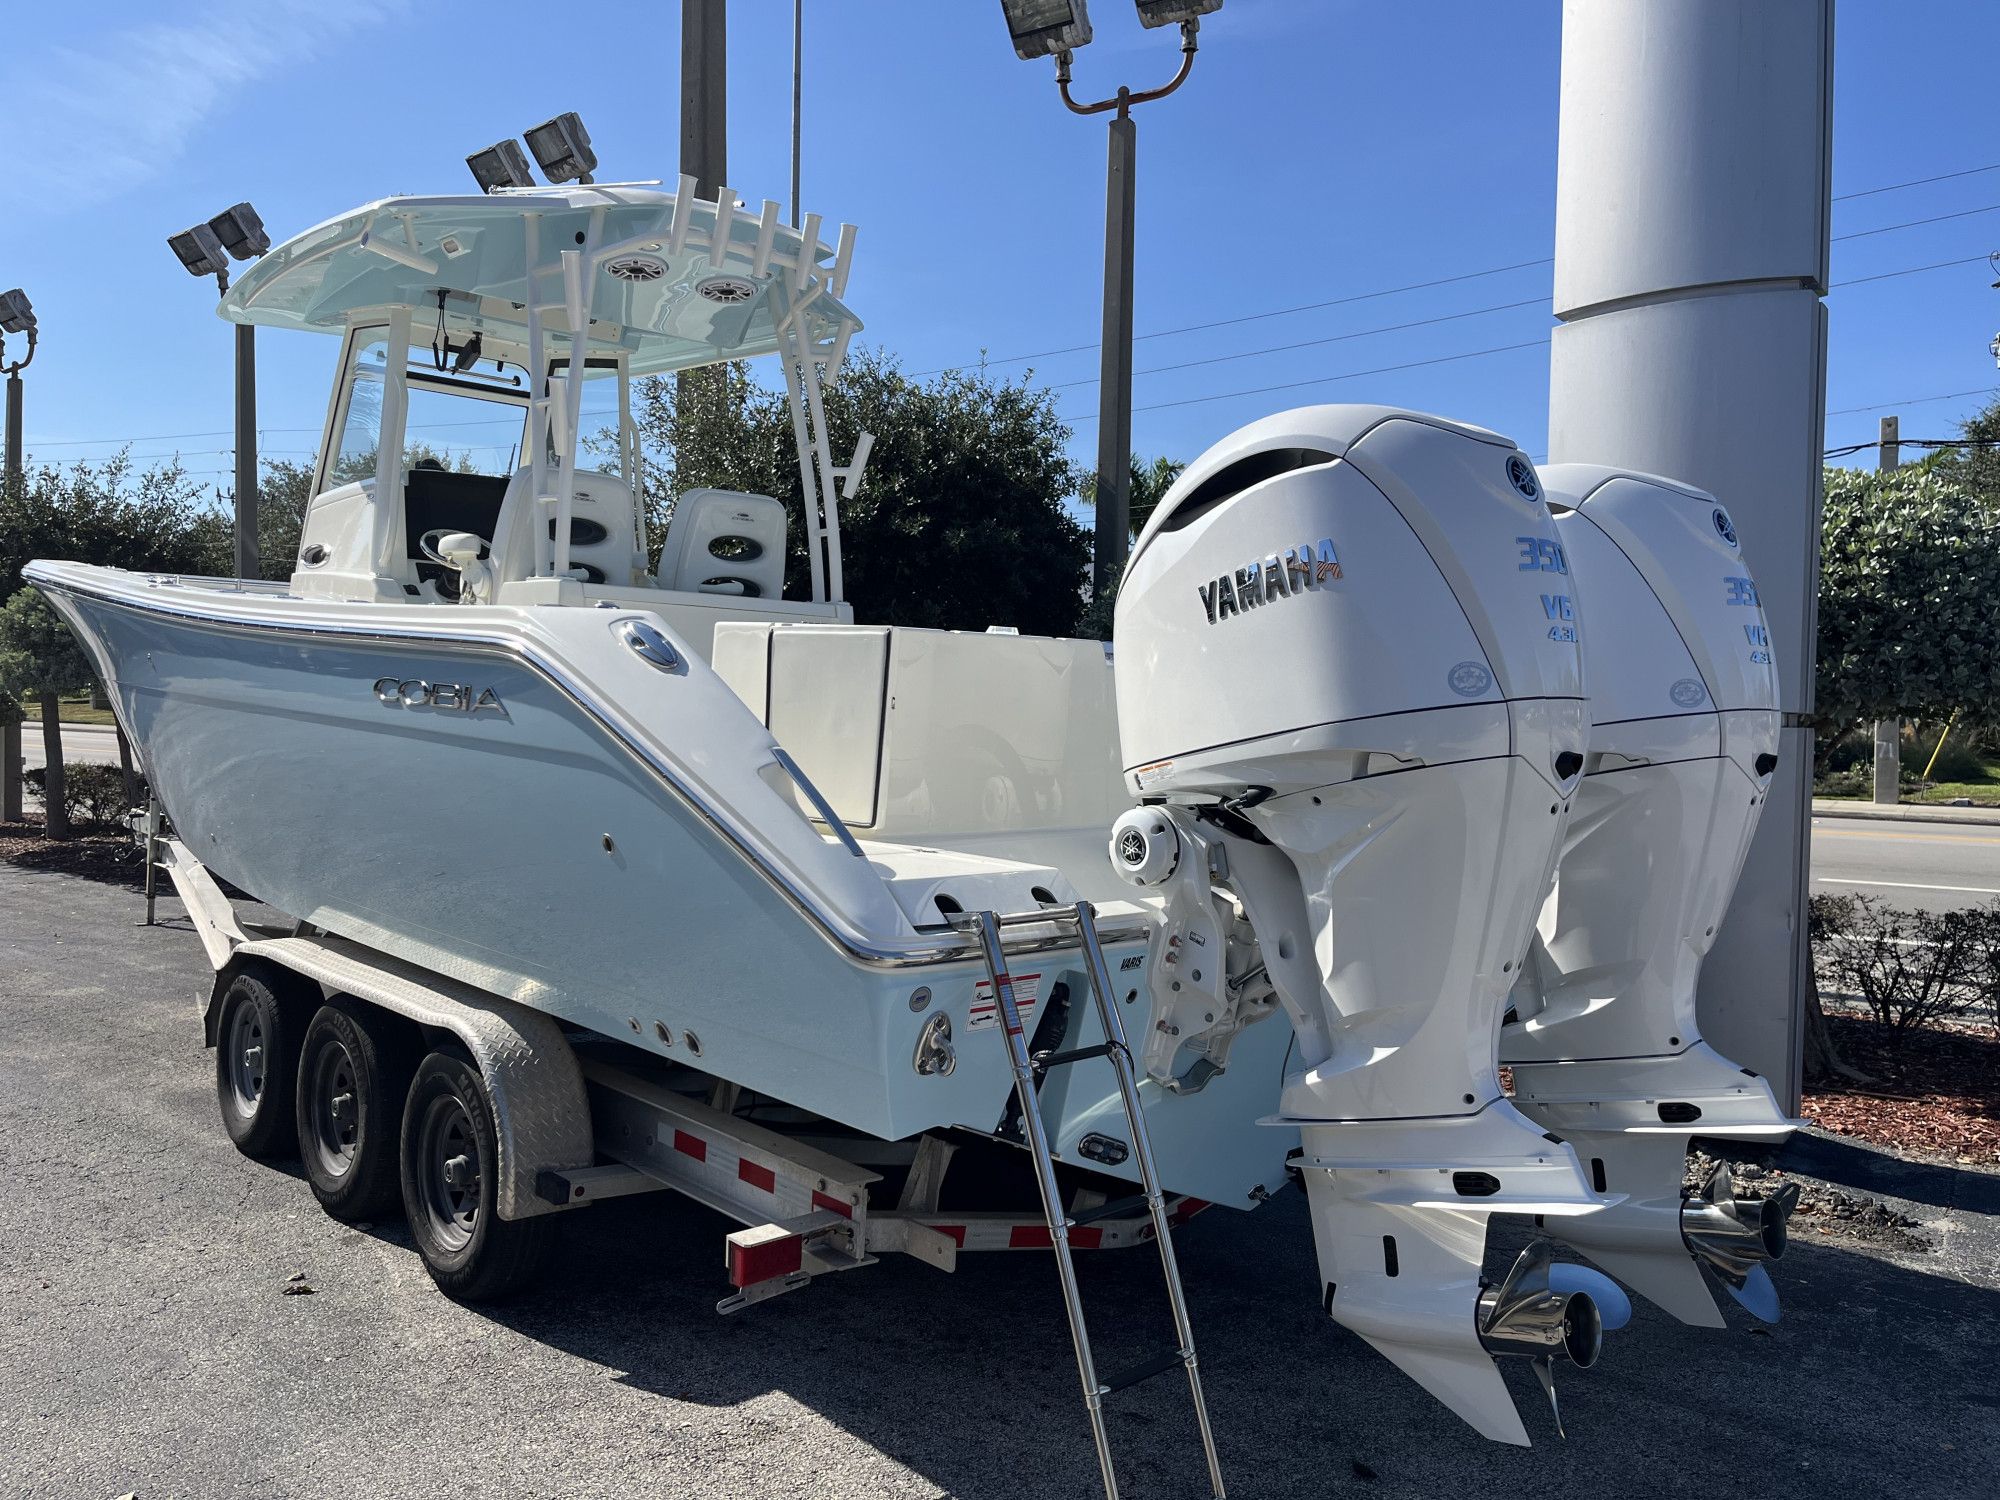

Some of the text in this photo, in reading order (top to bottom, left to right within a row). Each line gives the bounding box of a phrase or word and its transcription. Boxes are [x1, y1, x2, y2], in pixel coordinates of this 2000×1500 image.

[1515, 536, 1568, 576] 350
[1198, 537, 1343, 625] YAMAHA
[1540, 594, 1575, 621] V6
[373, 676, 514, 725] COBIA
[1120, 956, 1144, 970] VARIS
